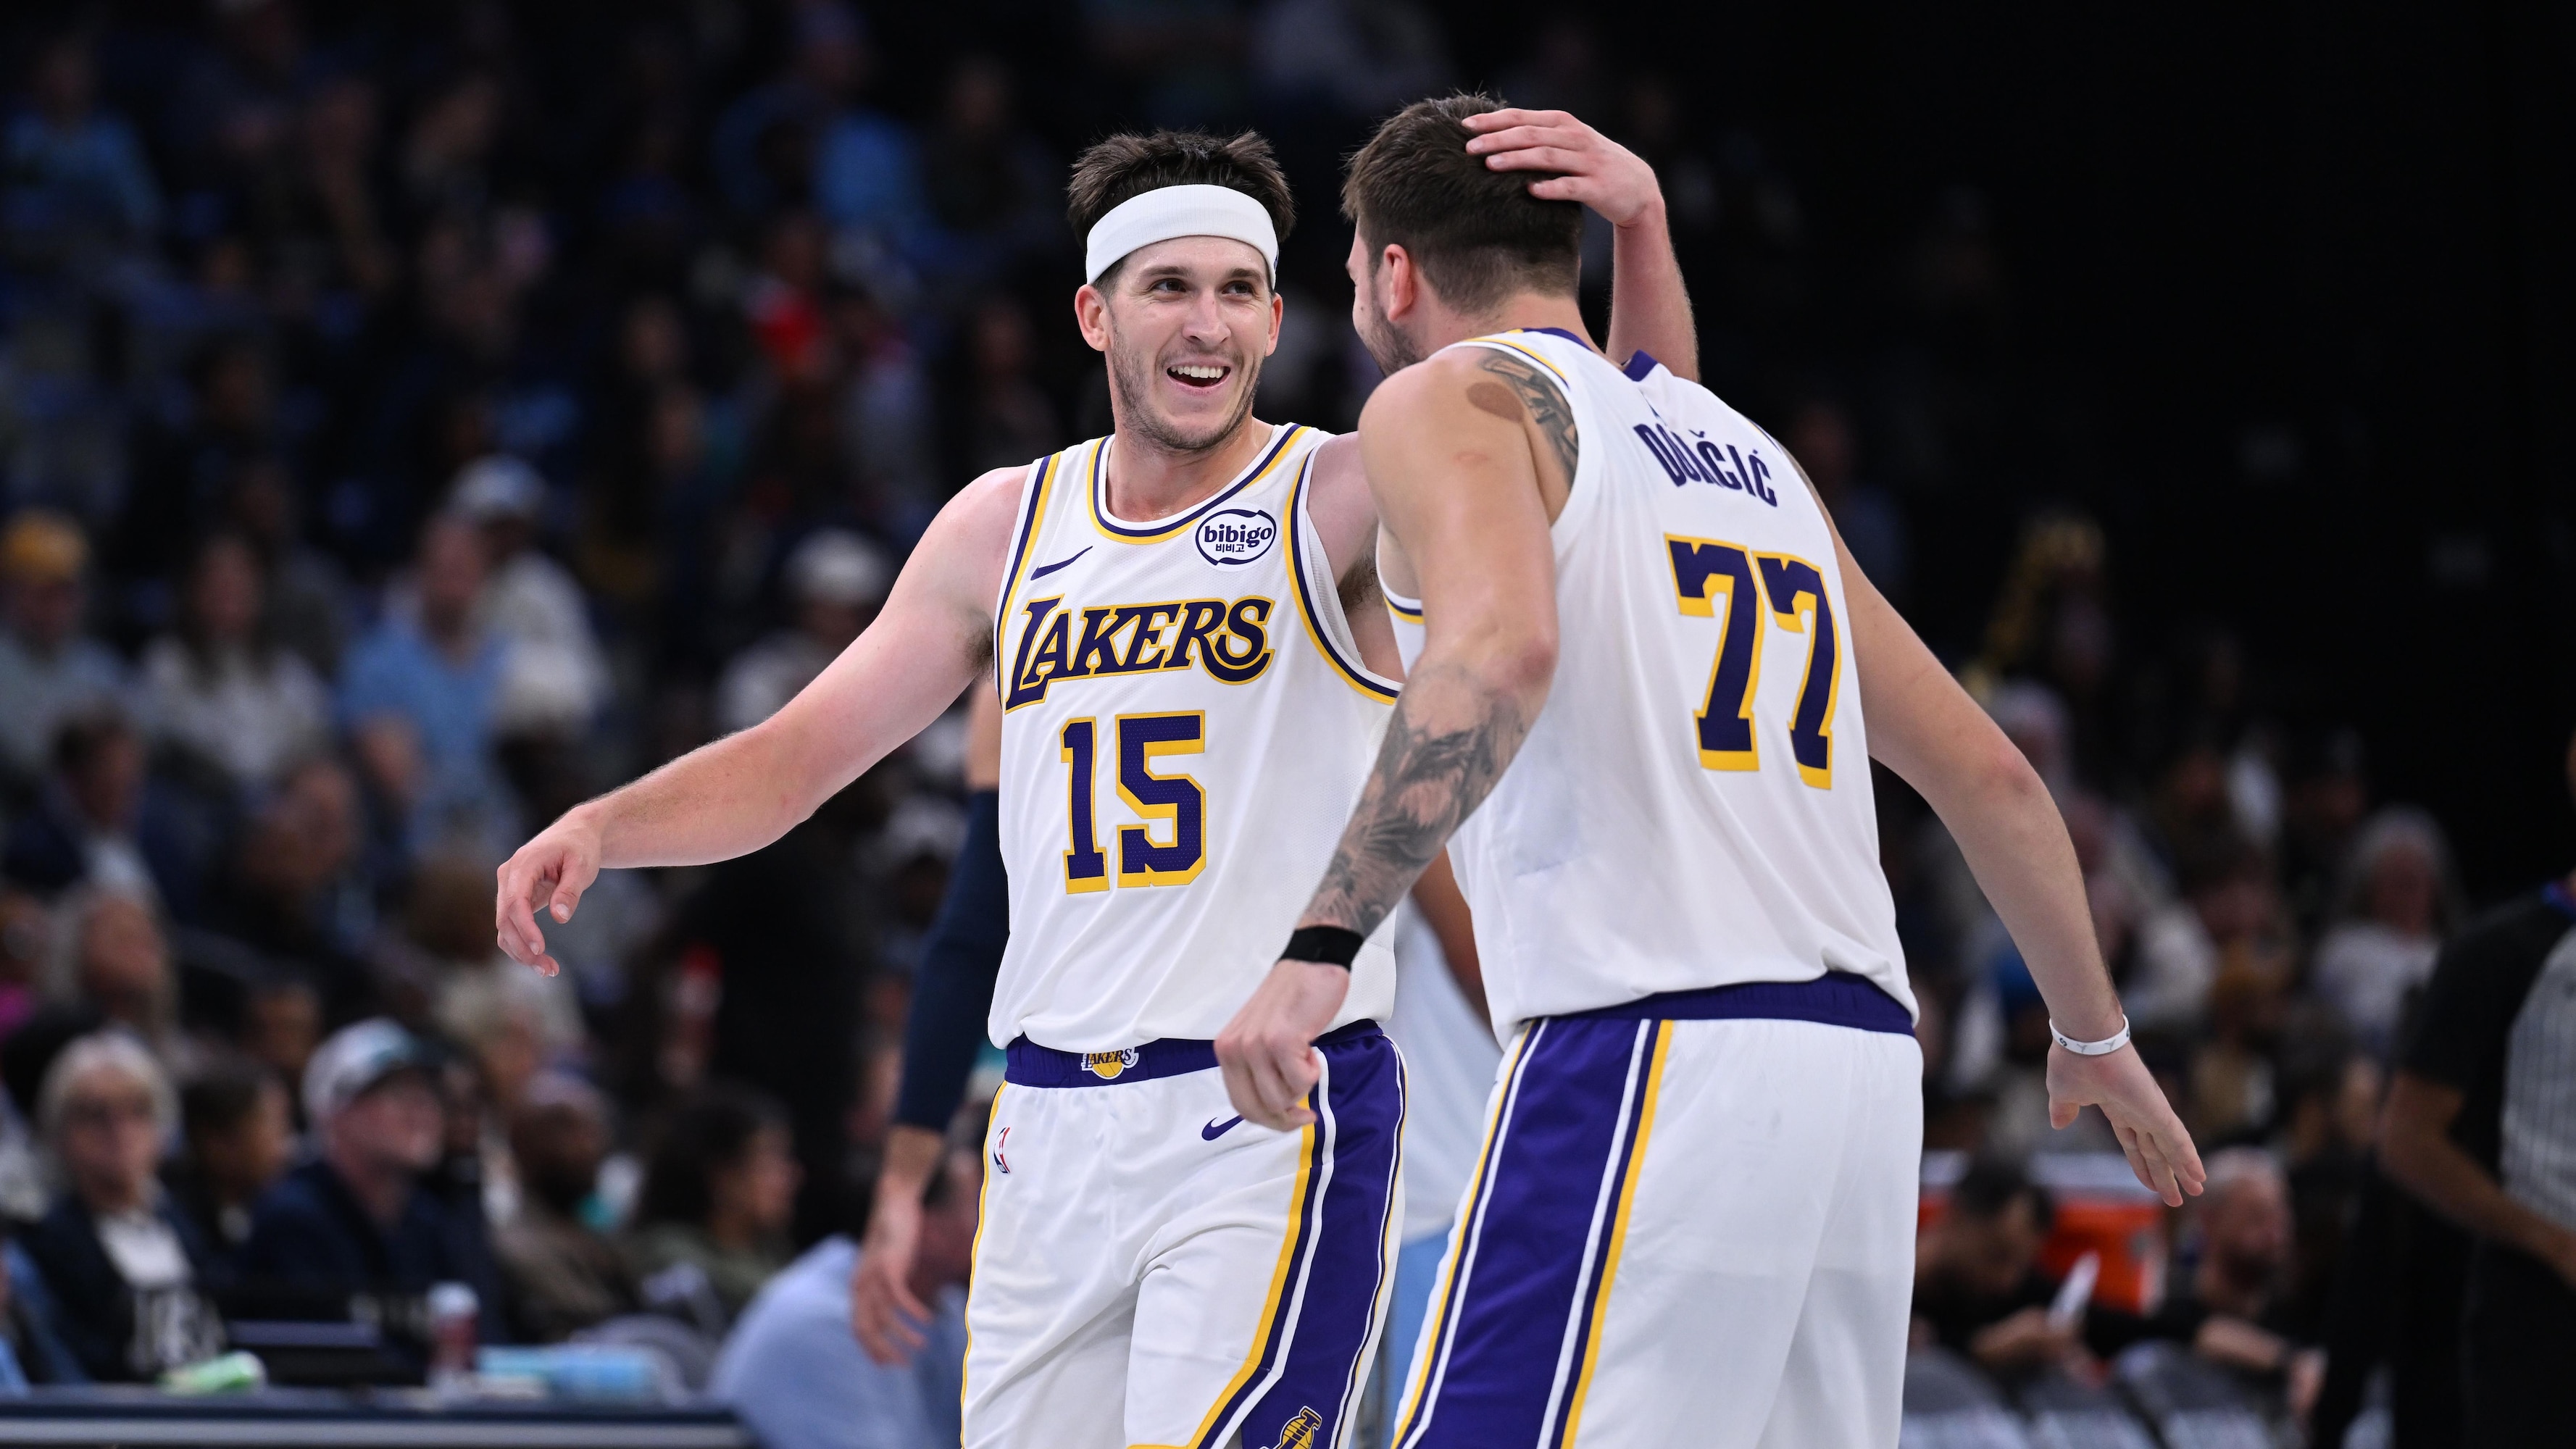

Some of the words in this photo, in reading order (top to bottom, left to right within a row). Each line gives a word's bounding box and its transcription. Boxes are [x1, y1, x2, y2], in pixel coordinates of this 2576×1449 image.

[1204, 524, 1272, 548] bibigo
[1215, 543, 1245, 553] 비비고
[1005, 593, 1275, 714] LAKERS
[1664, 533, 1841, 790] 77
[1059, 710, 1206, 894] 15
